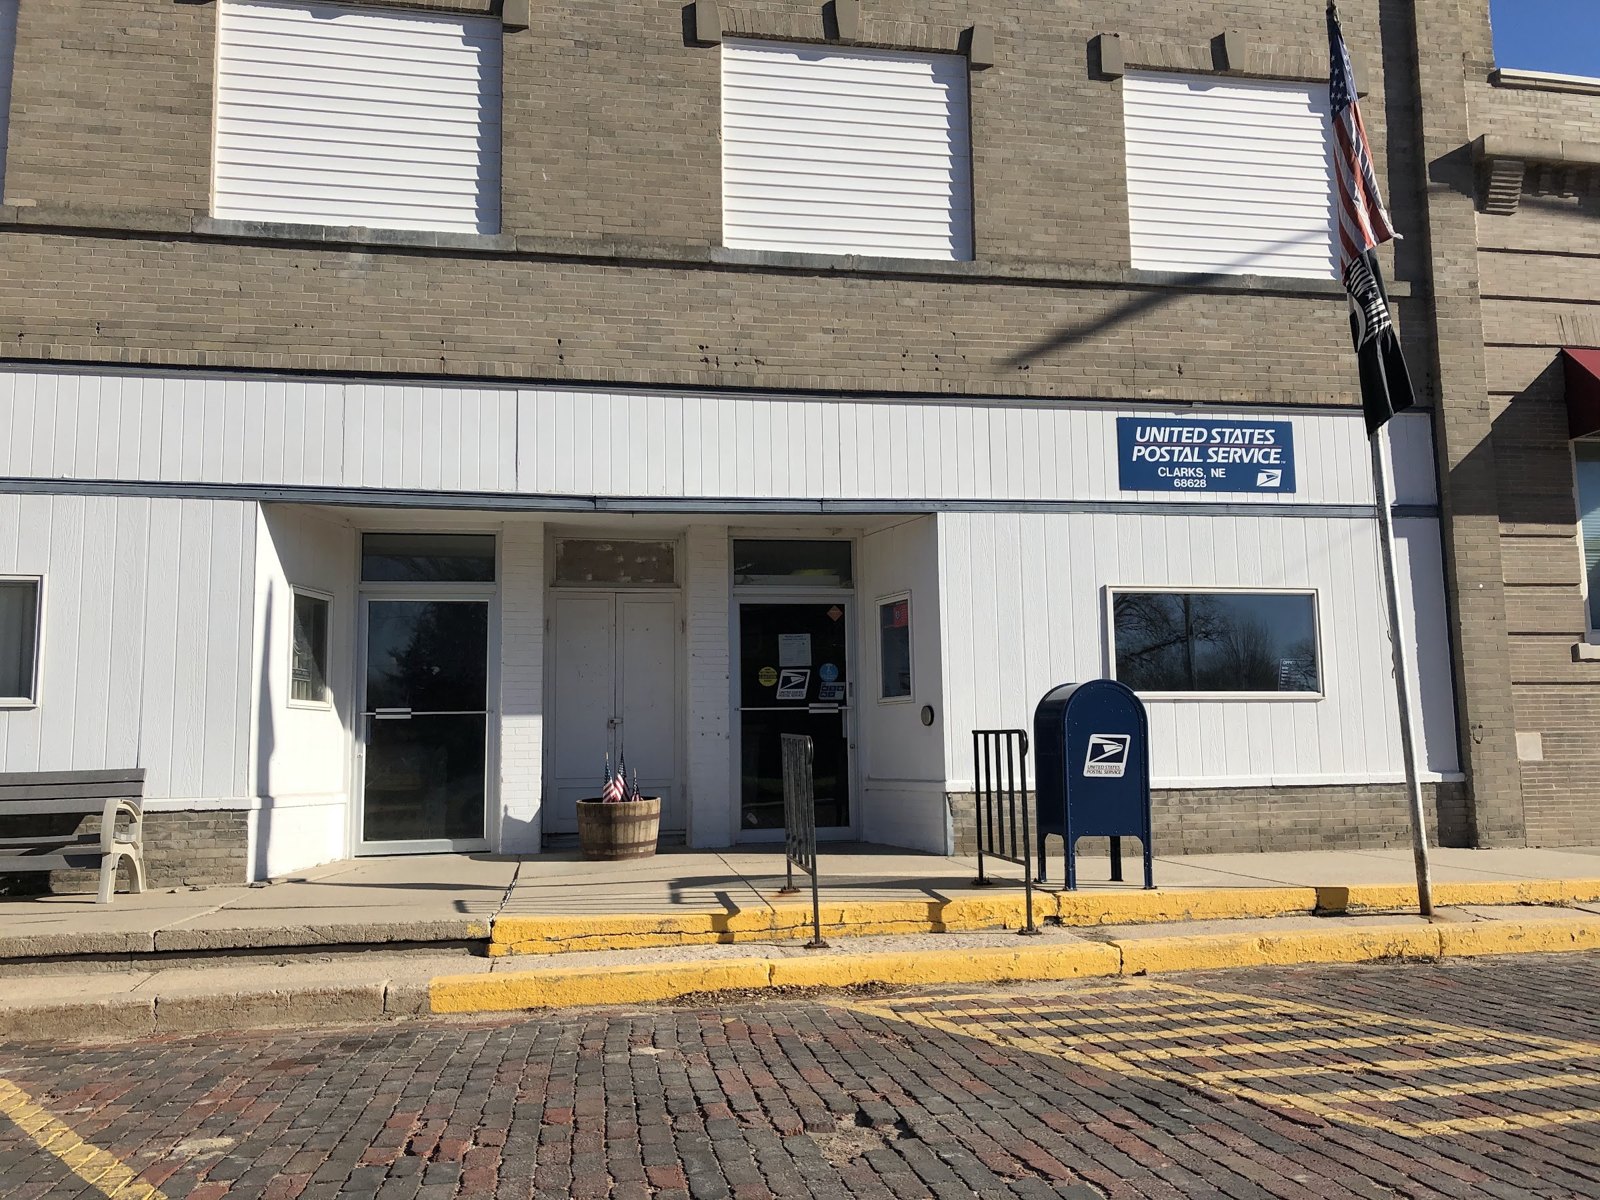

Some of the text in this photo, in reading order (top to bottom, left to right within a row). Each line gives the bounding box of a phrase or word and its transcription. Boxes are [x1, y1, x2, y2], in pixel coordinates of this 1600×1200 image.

[1135, 426, 1276, 445] UNITED STATES
[1132, 446, 1282, 464] POSTAL SERVICE
[1158, 466, 1226, 479] CLARKS, NE
[1173, 478, 1207, 488] 68628
